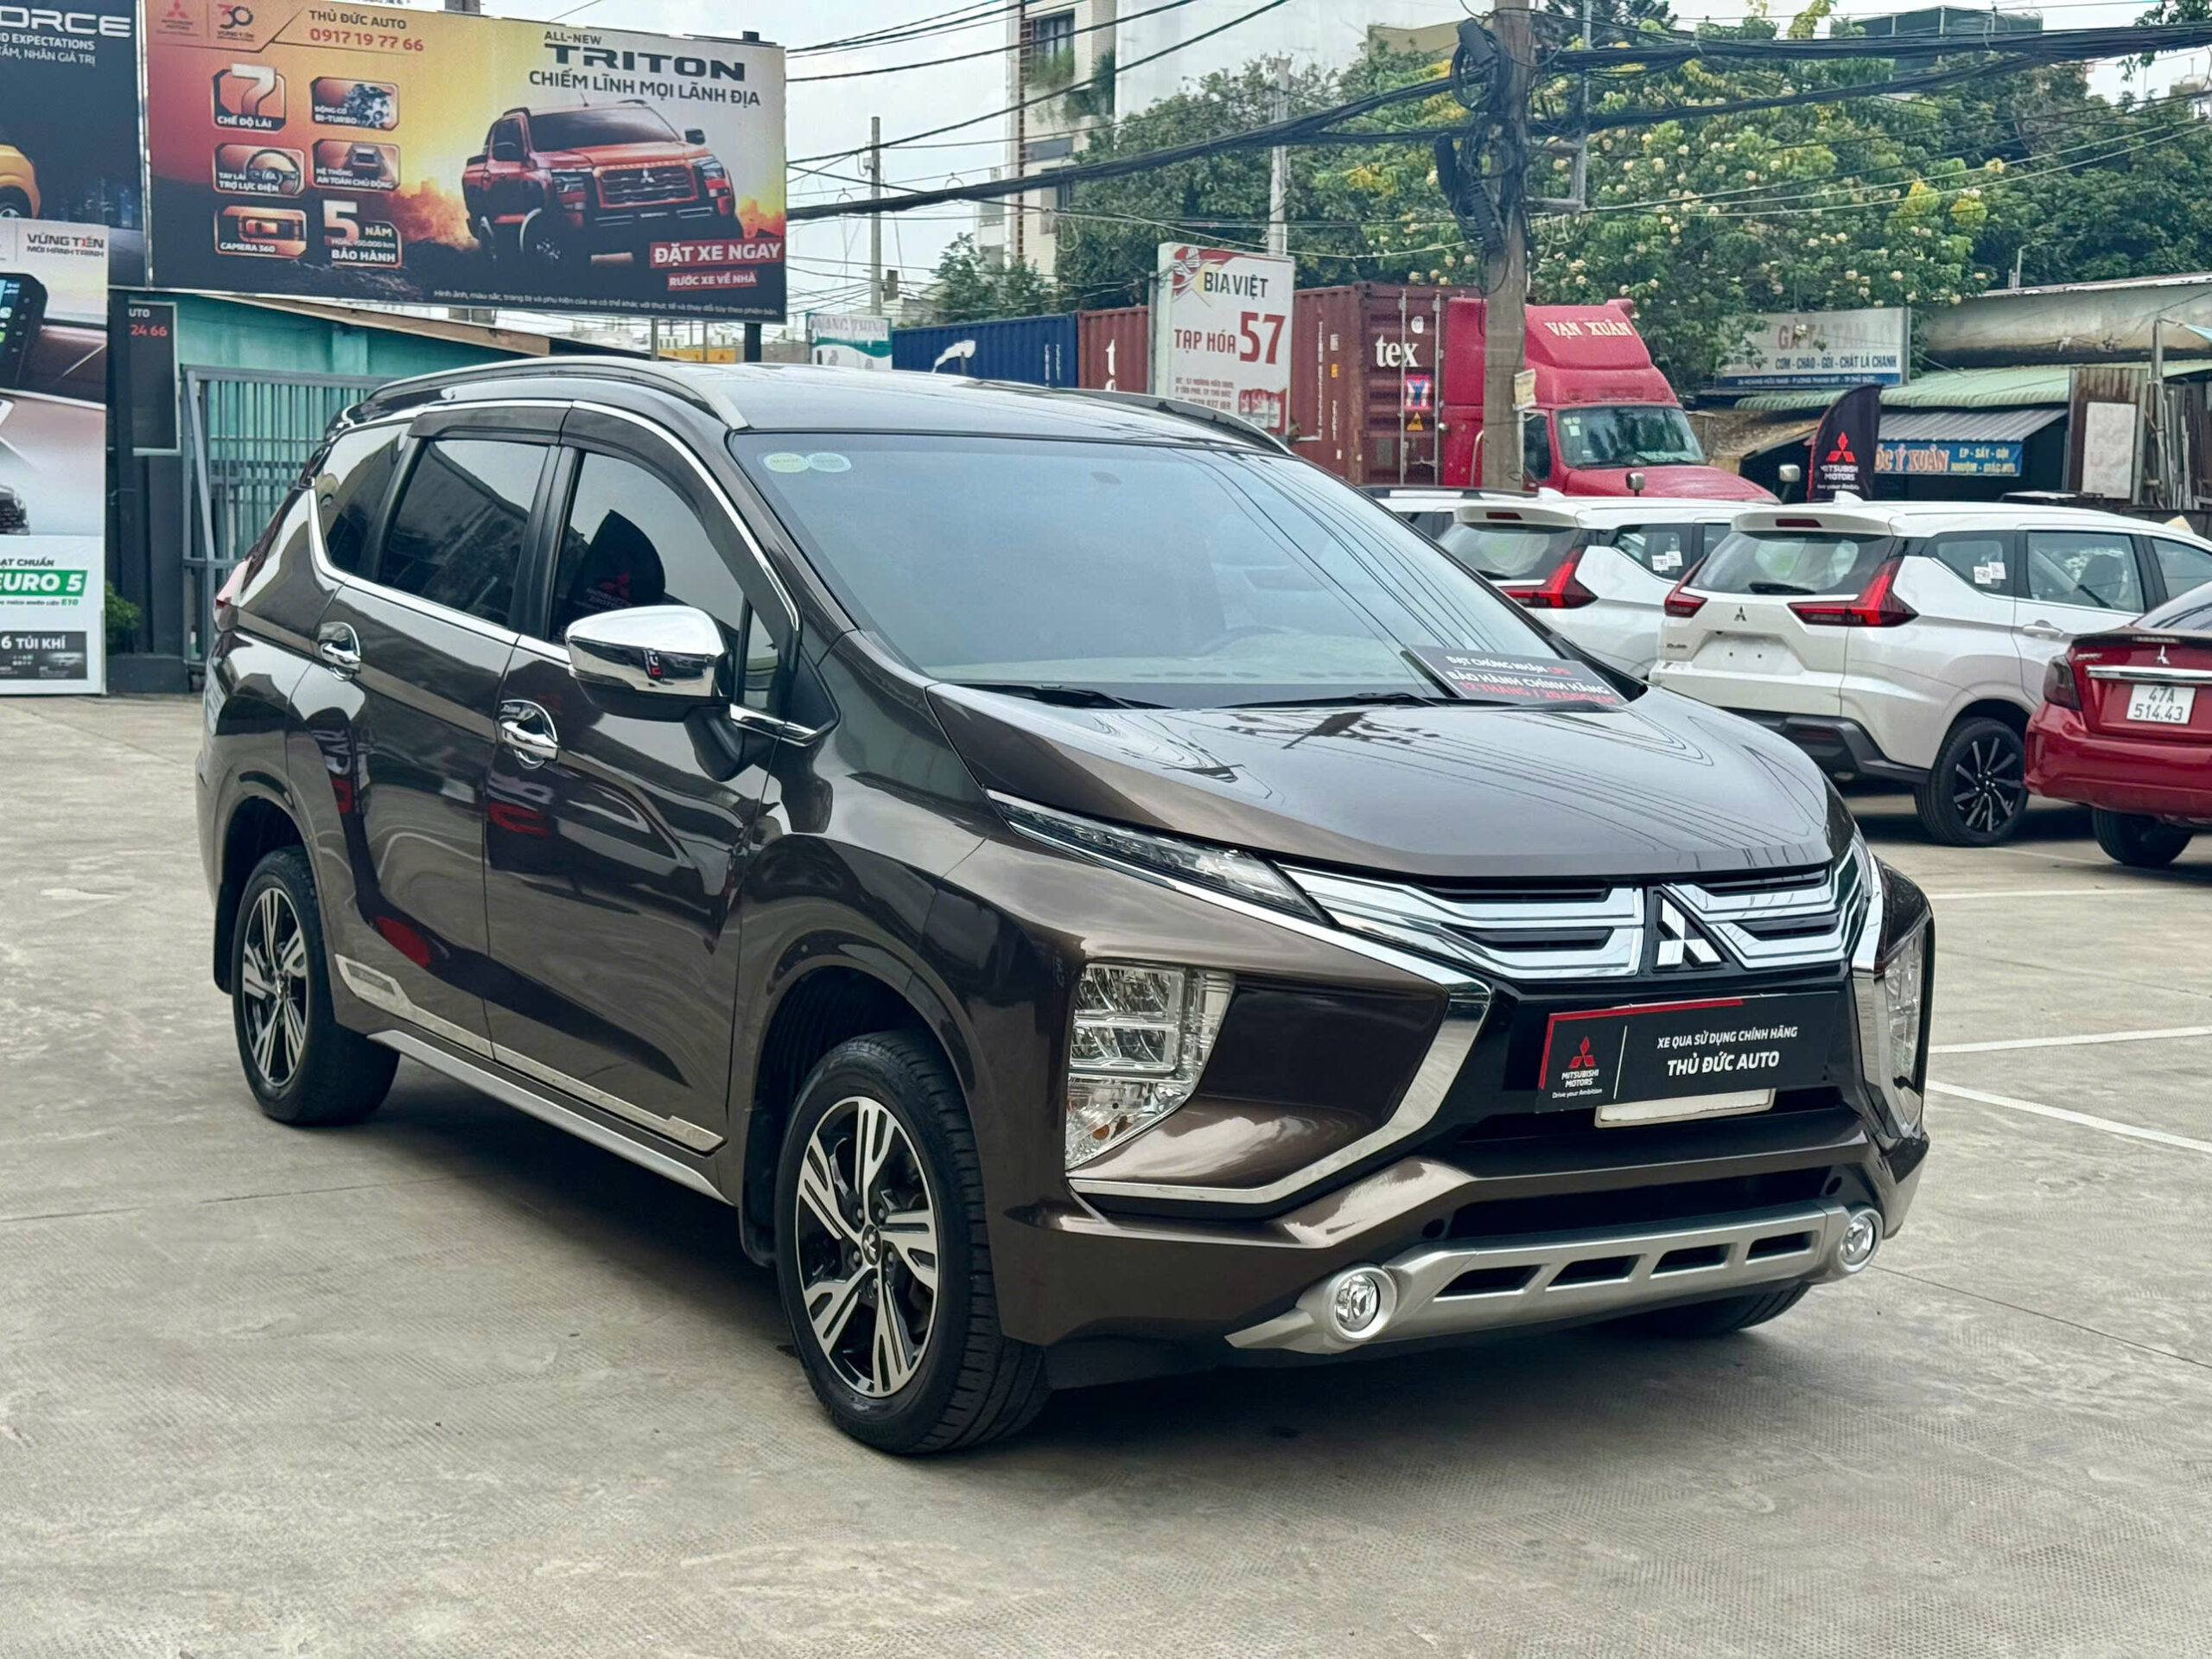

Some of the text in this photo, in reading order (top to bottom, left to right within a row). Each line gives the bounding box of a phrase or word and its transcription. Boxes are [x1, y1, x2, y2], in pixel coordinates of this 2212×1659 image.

[0, 5, 131, 37] ORCE
[309, 9, 407, 29] THỦ ĐỨC AUTO
[0, 32, 96, 51] D EXPECTATIONS
[309, 28, 423, 52] 0917 19 77 66
[544, 31, 602, 45] ALL-NEW
[79, 54, 96, 67] TRỊ
[544, 43, 745, 82] TRITON
[231, 63, 275, 115] 7
[530, 68, 760, 108] CHIẾM LĨNH MỌI LÃNH ĐỊA
[217, 113, 272, 128] CHẾ ĐỘ LÁI
[219, 180, 238, 191] TRỢ
[323, 200, 359, 246] 5
[364, 225, 393, 237] NĂM
[219, 243, 259, 252] CAMERA
[331, 247, 396, 263] BẢO HÀNH
[654, 243, 782, 266] ĐẶT XE NGAY
[669, 272, 757, 286] RƯỚC XE VỀ NHÀ
[1205, 271, 1268, 300] BIA VIỆT
[130, 324, 168, 337] 24 66
[1174, 311, 1286, 365] TẠP HÓA 57
[1544, 319, 1634, 340] VẠN XUÂN
[1375, 334, 1420, 368] tex
[66, 574, 84, 593] 5
[1, 635, 67, 650] 6 TÚI KHÍ
[1446, 670, 1611, 695] BẢO HÀNH CHÍNH HÃNG
[2148, 687, 2175, 703] 47A
[2133, 703, 2183, 721] 514.43
[1657, 1025, 1798, 1050] XE QUA SỬ DỤNG CHÍNH HÃNG
[1667, 1051, 1780, 1077] THỦ ĐỨC AUTO
[1561, 1069, 1599, 1080] MITSUBISHI
[1565, 1078, 1593, 1088] MOTORS
[1579, 1088, 1603, 1096] Ambition
